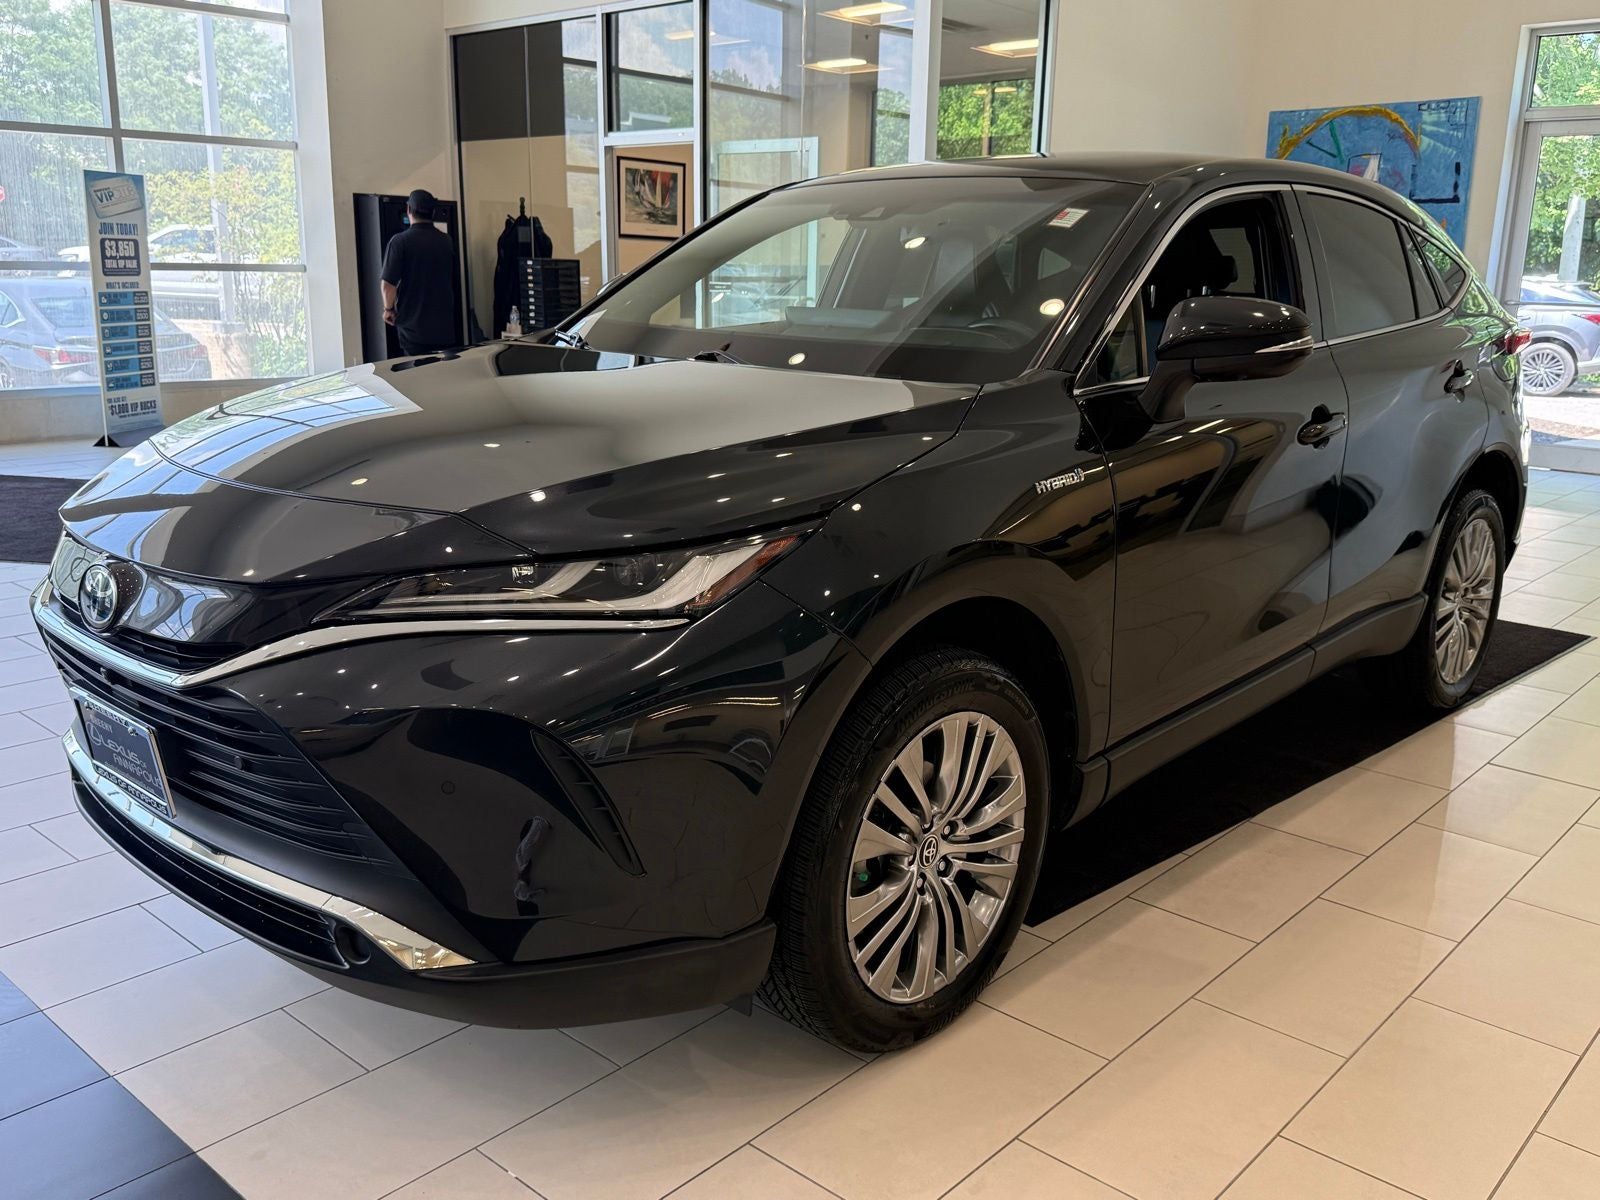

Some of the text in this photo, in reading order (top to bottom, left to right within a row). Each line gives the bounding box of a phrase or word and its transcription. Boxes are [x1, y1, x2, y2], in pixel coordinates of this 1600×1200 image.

[95, 190, 114, 204] VIP
[99, 222, 138, 236] JOIN TODAY!
[105, 240, 135, 259] $3,850
[105, 259, 118, 268] TOTAL
[125, 259, 138, 268] VALUE
[130, 402, 138, 412] VIP
[140, 400, 156, 411] BUCKS
[1035, 472, 1078, 494] HYBRID
[100, 735, 140, 763] LEXUS
[96, 766, 117, 785] LEXUS
[117, 778, 128, 791] OF
[127, 785, 168, 815] ANNAPOLIS
